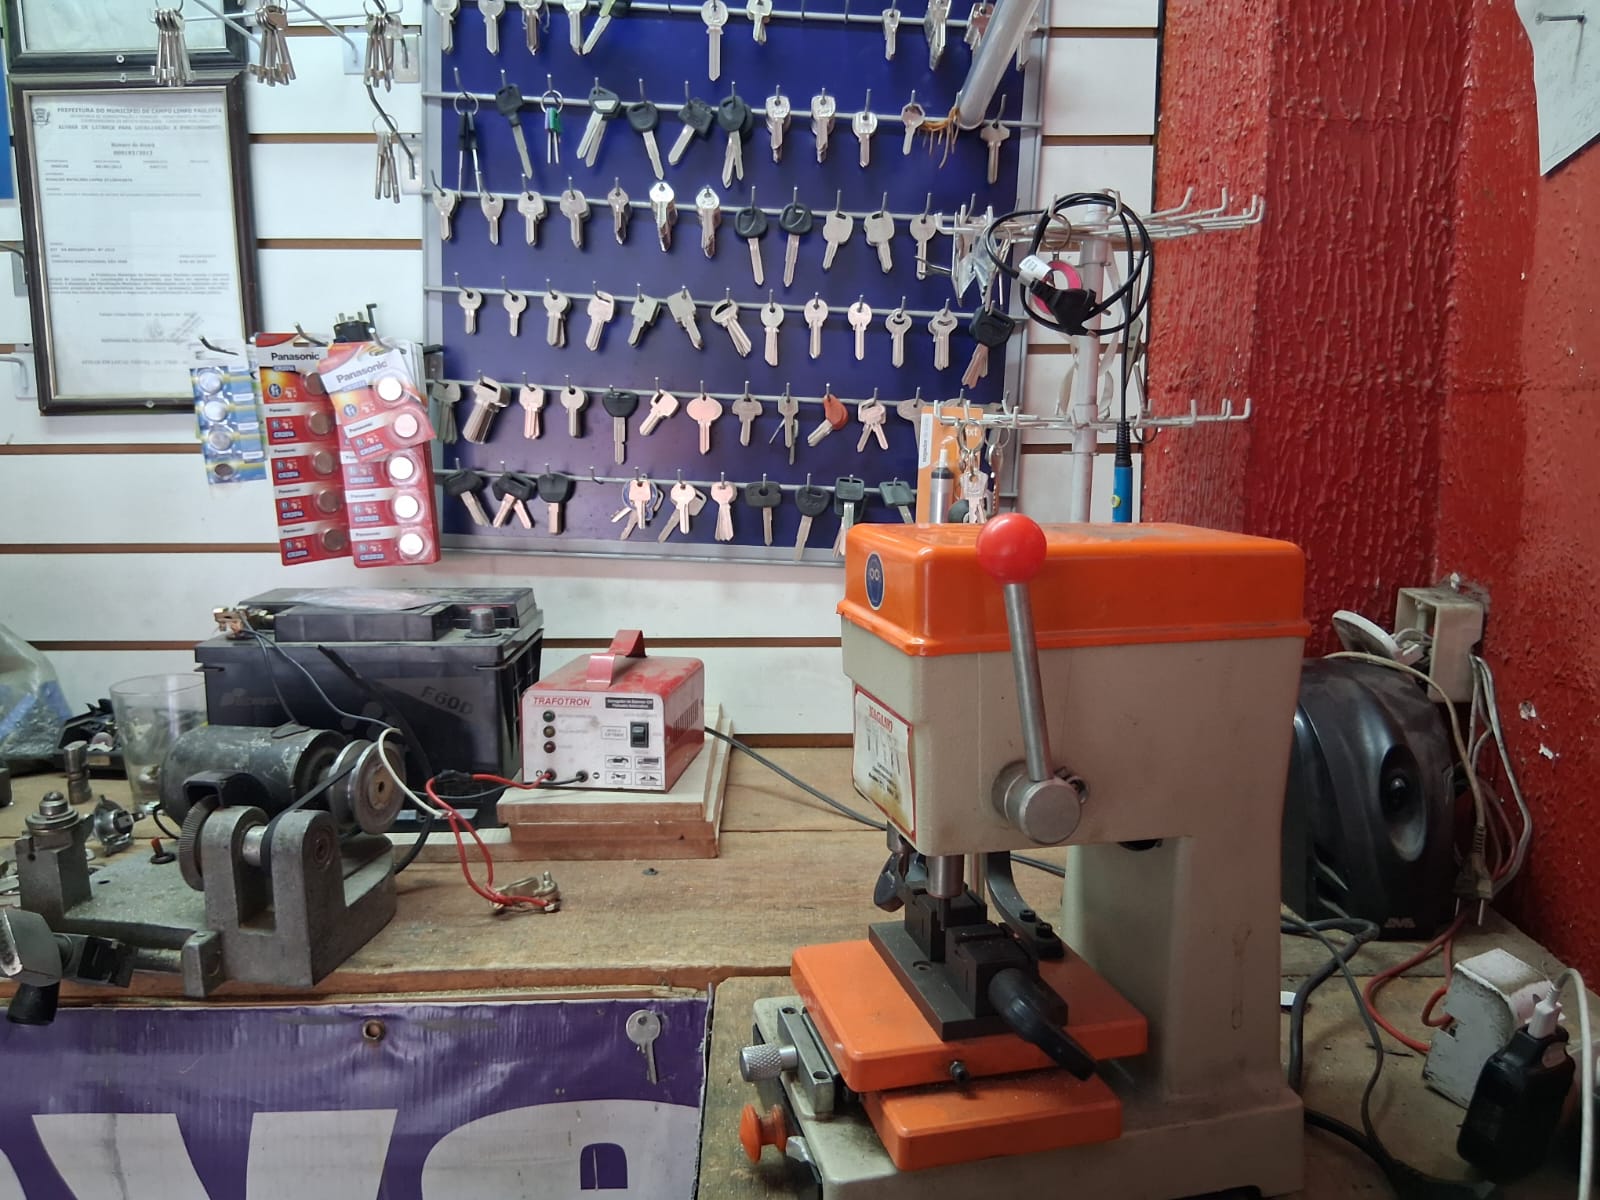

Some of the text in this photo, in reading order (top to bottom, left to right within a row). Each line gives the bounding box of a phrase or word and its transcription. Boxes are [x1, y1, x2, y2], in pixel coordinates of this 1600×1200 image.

[271, 352, 320, 361] Panasonic
[336, 360, 388, 383] Panasonic
[533, 696, 590, 706] TRAFOTRON
